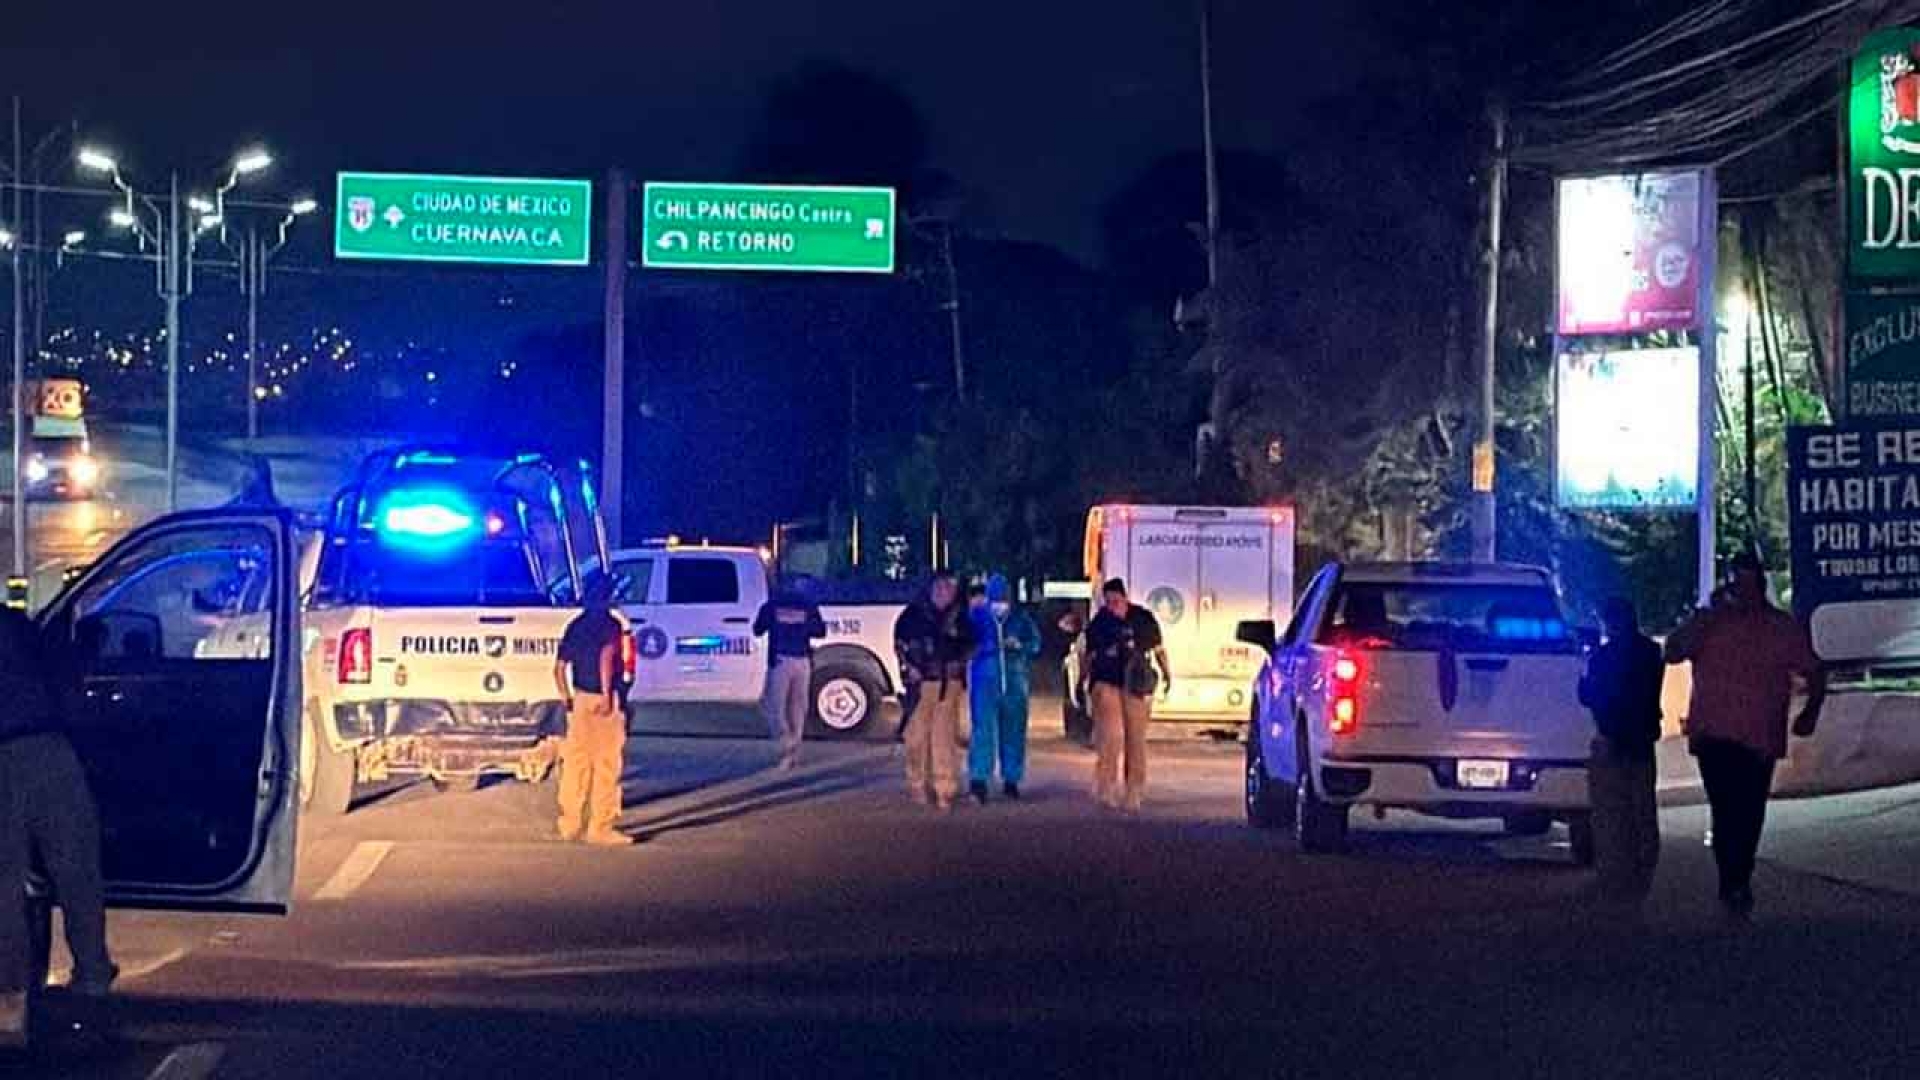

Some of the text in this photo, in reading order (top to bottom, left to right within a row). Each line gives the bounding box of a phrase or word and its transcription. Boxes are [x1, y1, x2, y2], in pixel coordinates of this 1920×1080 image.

[412, 191, 476, 212] CIUDAD
[480, 193, 502, 214] DE
[653, 200, 795, 220] CHILPANCINGO
[411, 222, 564, 247] CUERNAVACA
[698, 230, 794, 253] RETORNO
[1850, 305, 1920, 370] EXCLU
[1807, 431, 1861, 468] SE
[1800, 473, 1920, 513] HABITA
[1813, 518, 1920, 552] POR MES
[401, 635, 558, 655] POLICIA MINIST
